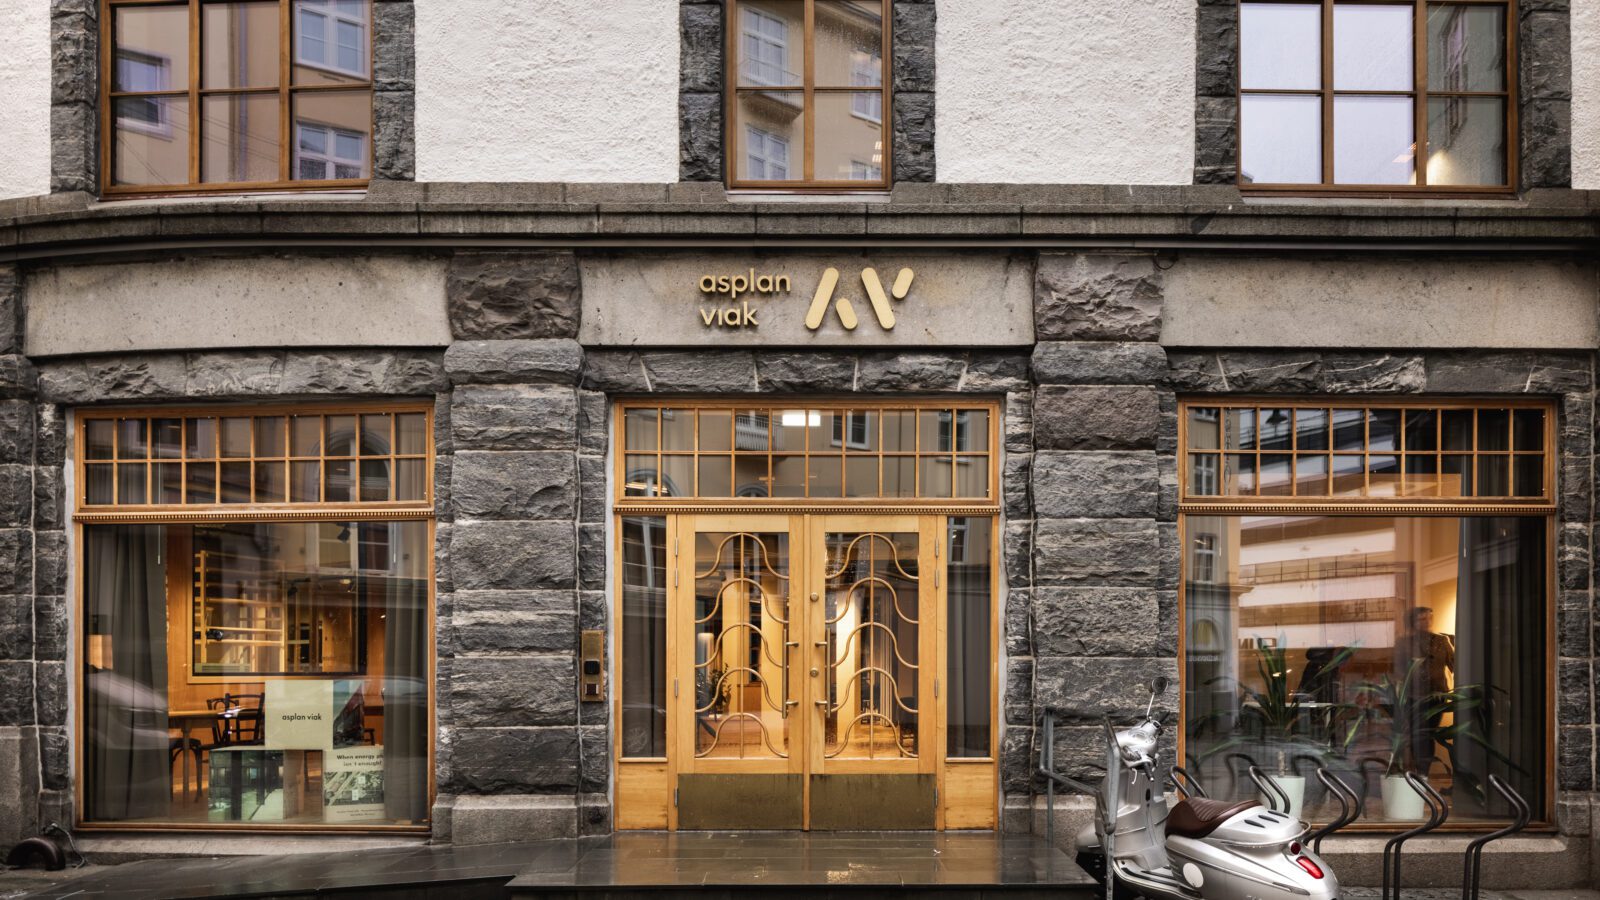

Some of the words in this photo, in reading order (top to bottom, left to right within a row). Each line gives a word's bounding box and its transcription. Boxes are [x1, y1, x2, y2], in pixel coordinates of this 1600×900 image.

[699, 267, 791, 298] asplan
[700, 301, 760, 326] viak
[282, 712, 306, 723] asplan
[307, 712, 322, 721] viak
